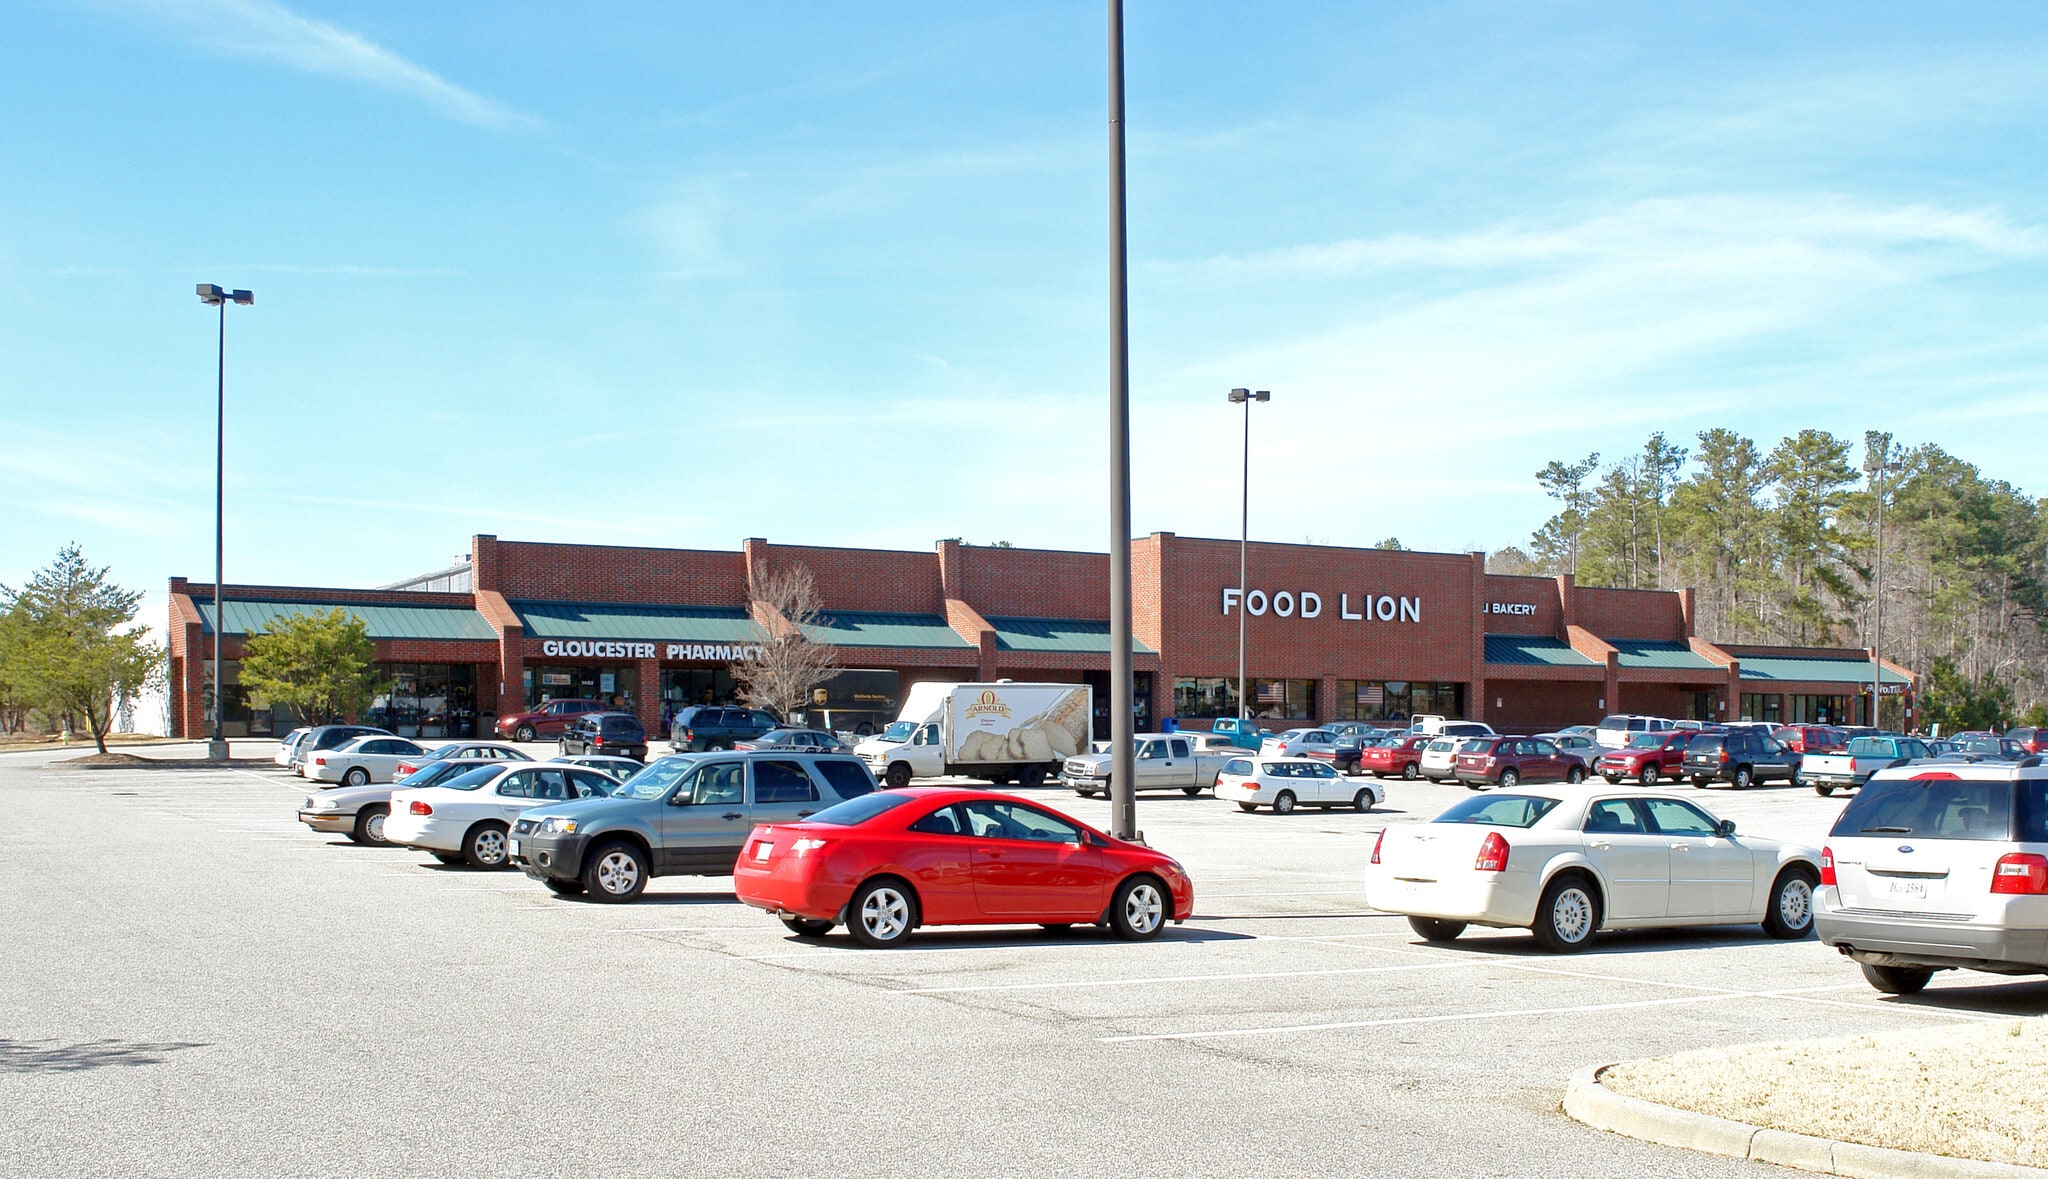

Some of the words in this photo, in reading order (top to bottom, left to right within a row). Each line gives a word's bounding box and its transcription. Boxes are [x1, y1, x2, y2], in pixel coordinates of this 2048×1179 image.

[1222, 587, 1322, 618] FOOD
[1341, 592, 1421, 623] LION
[1492, 602, 1537, 616] BAKERY
[543, 640, 656, 658] GLOUCESTER
[667, 644, 763, 661] PHARMACY
[973, 704, 1005, 713] ARNOLD
